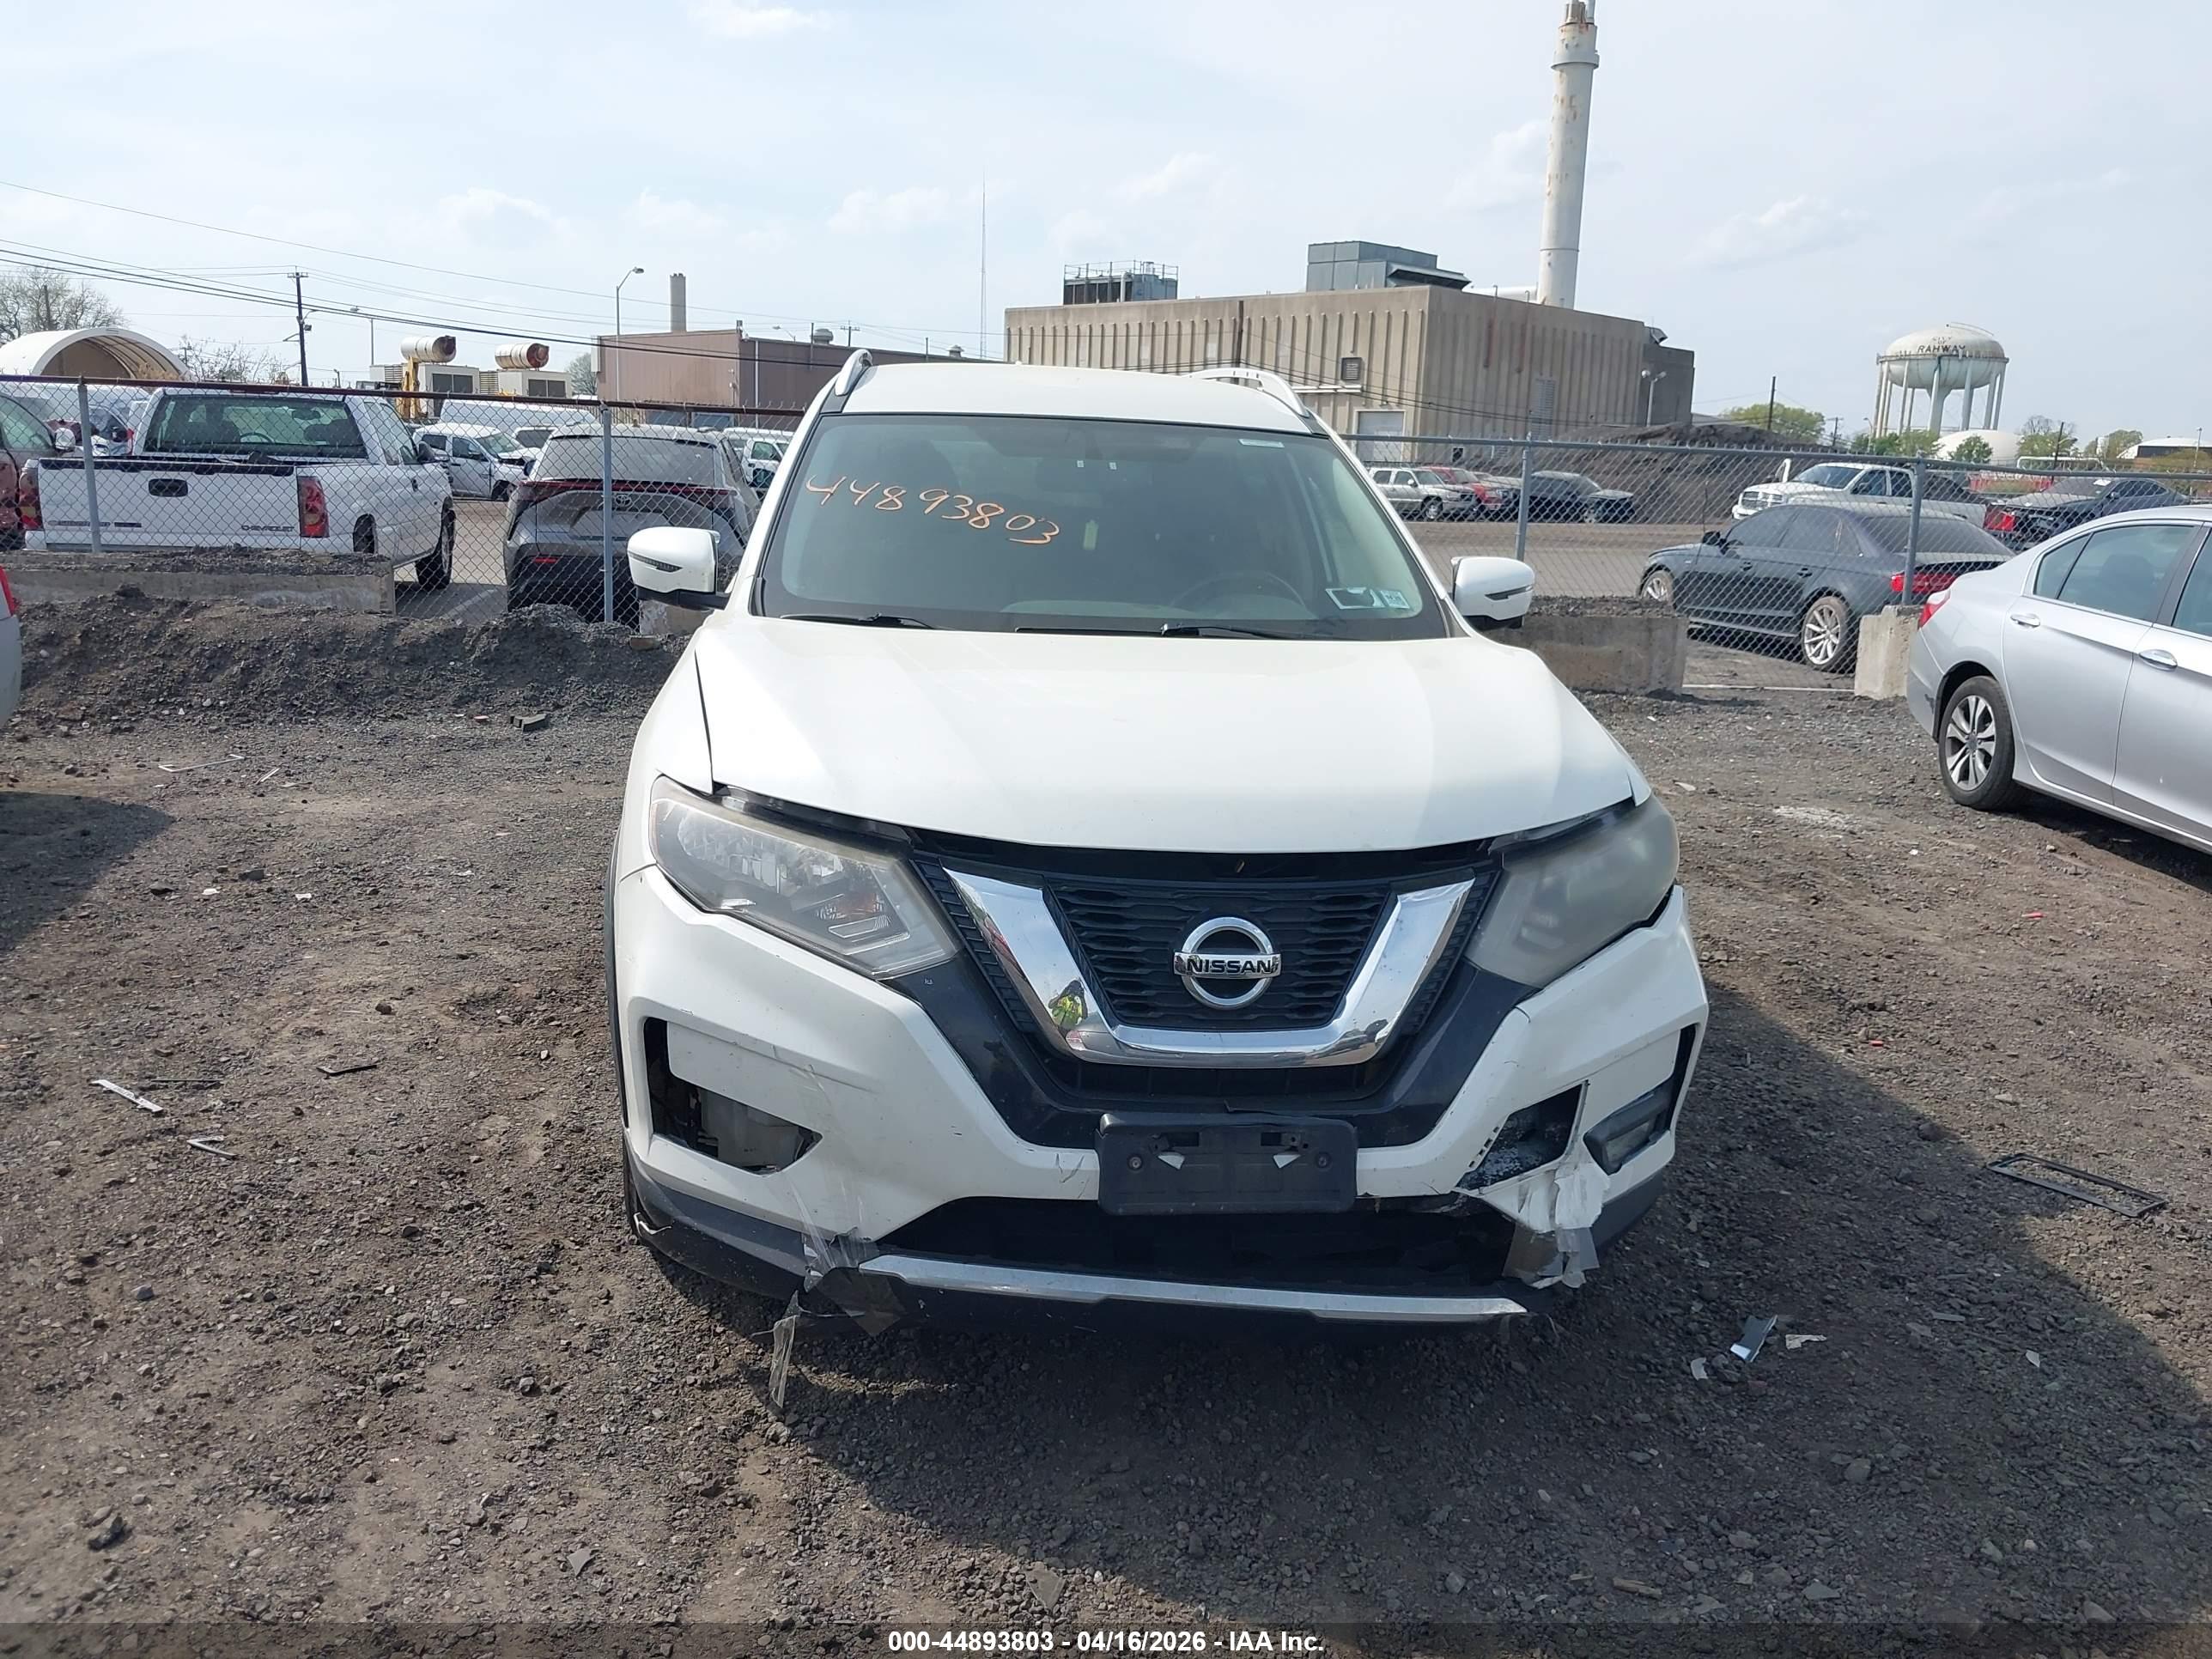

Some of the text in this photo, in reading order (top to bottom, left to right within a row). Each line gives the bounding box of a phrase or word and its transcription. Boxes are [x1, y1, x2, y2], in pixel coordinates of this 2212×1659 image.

[1917, 343, 1966, 354] RAHWAY
[805, 473, 1060, 545] 44893803
[1186, 957, 1273, 975] NISSAN
